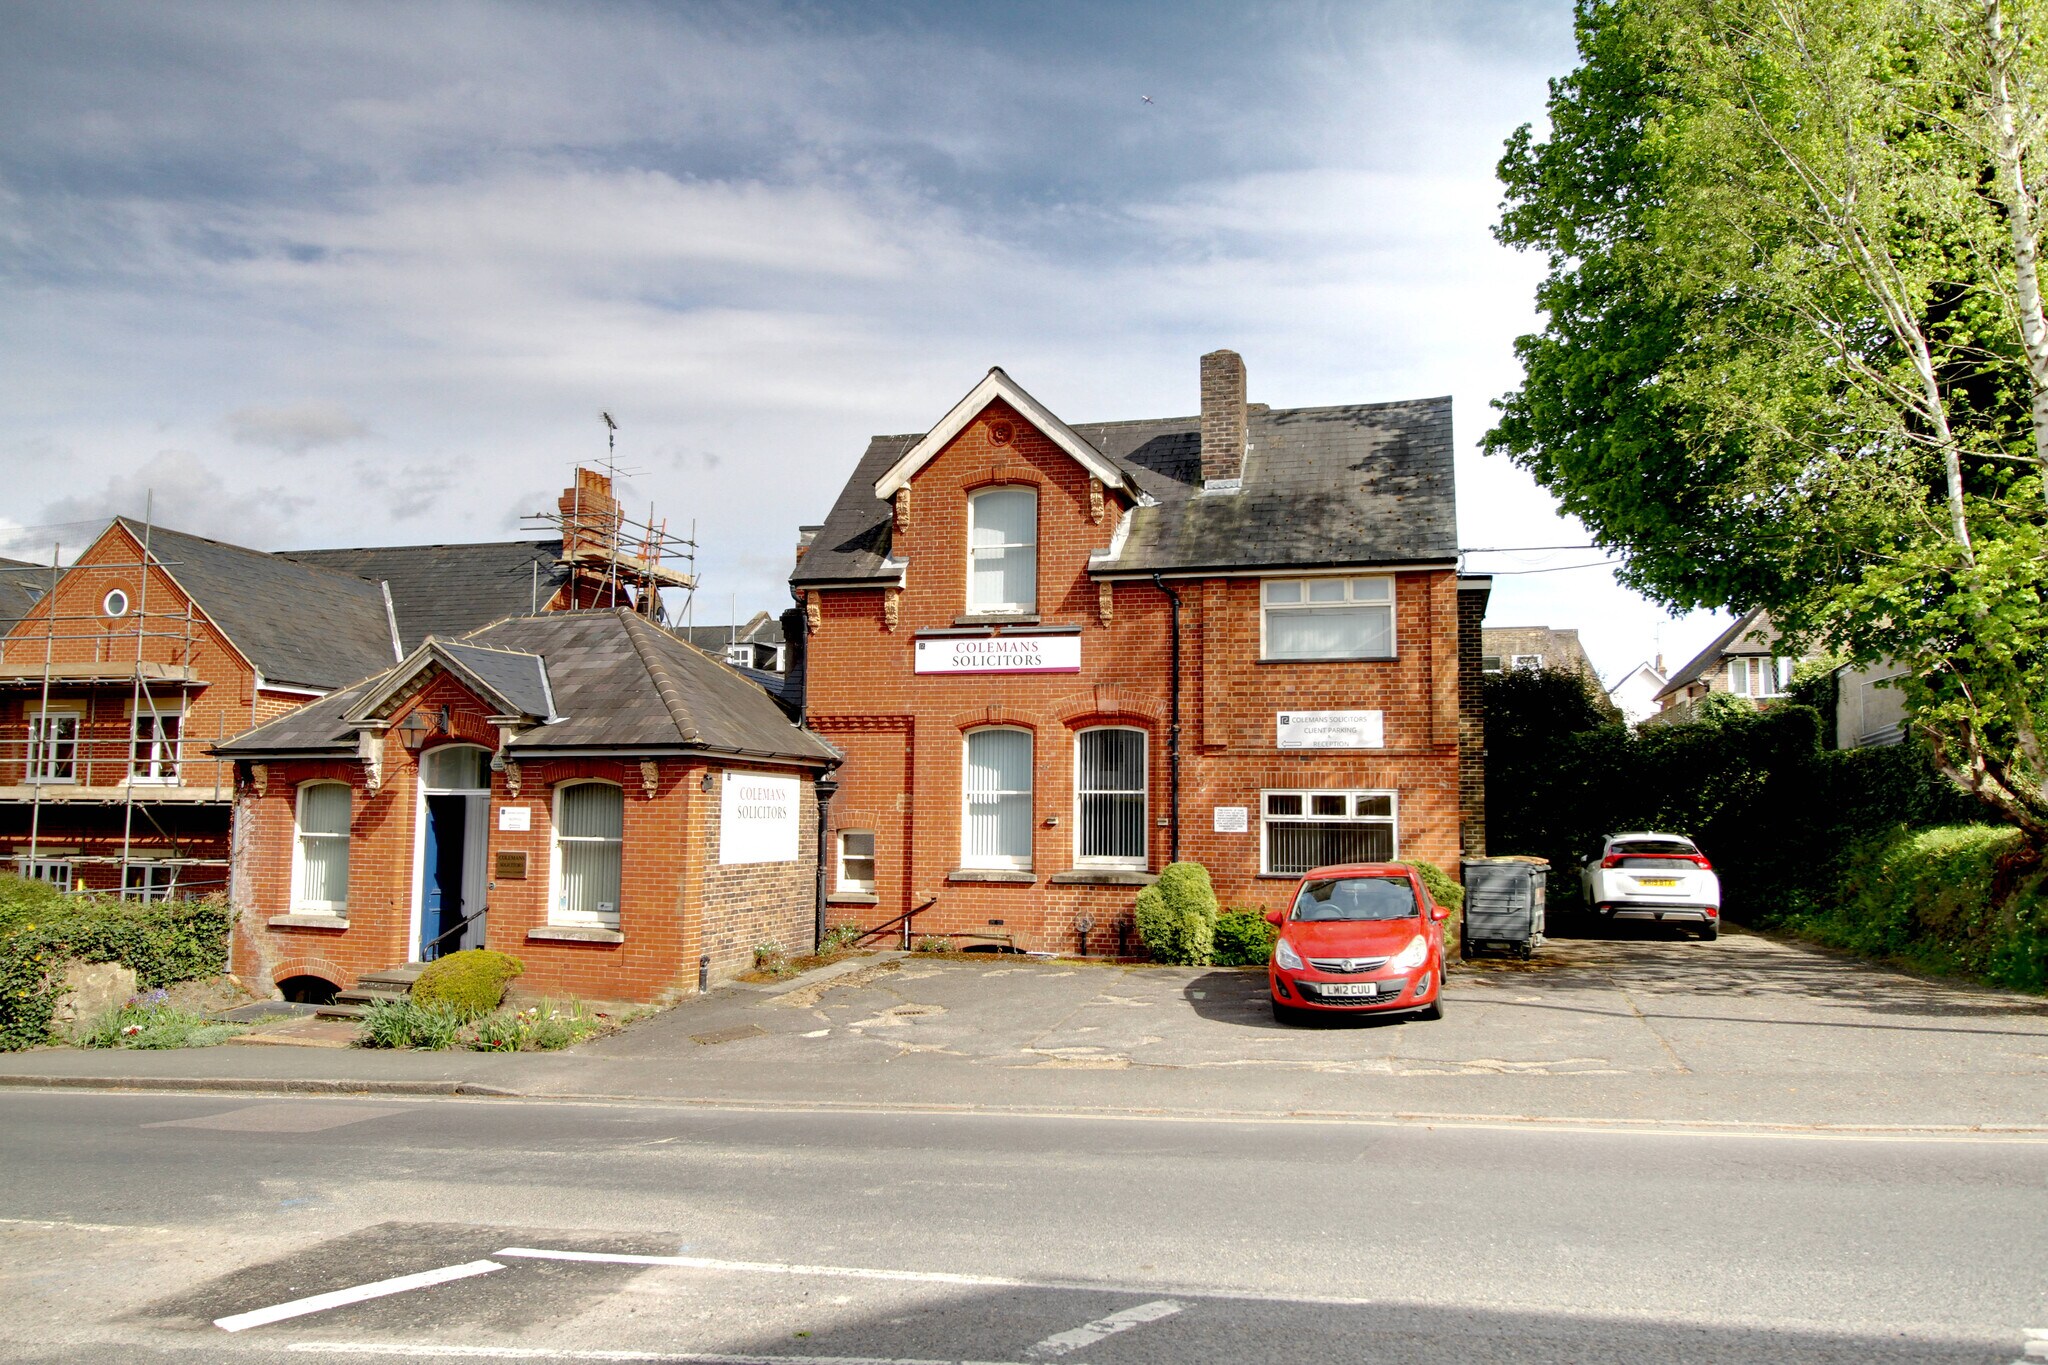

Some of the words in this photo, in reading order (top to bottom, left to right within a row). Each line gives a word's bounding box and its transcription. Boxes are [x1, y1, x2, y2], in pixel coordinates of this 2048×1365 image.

[955, 641, 1039, 654] COLEMANS
[952, 654, 1042, 667] SOLICITORS
[740, 787, 786, 801] COLEMANS
[737, 805, 787, 819] SOLICITORS
[1327, 985, 1349, 995] LM12
[1350, 985, 1370, 995] CUU
